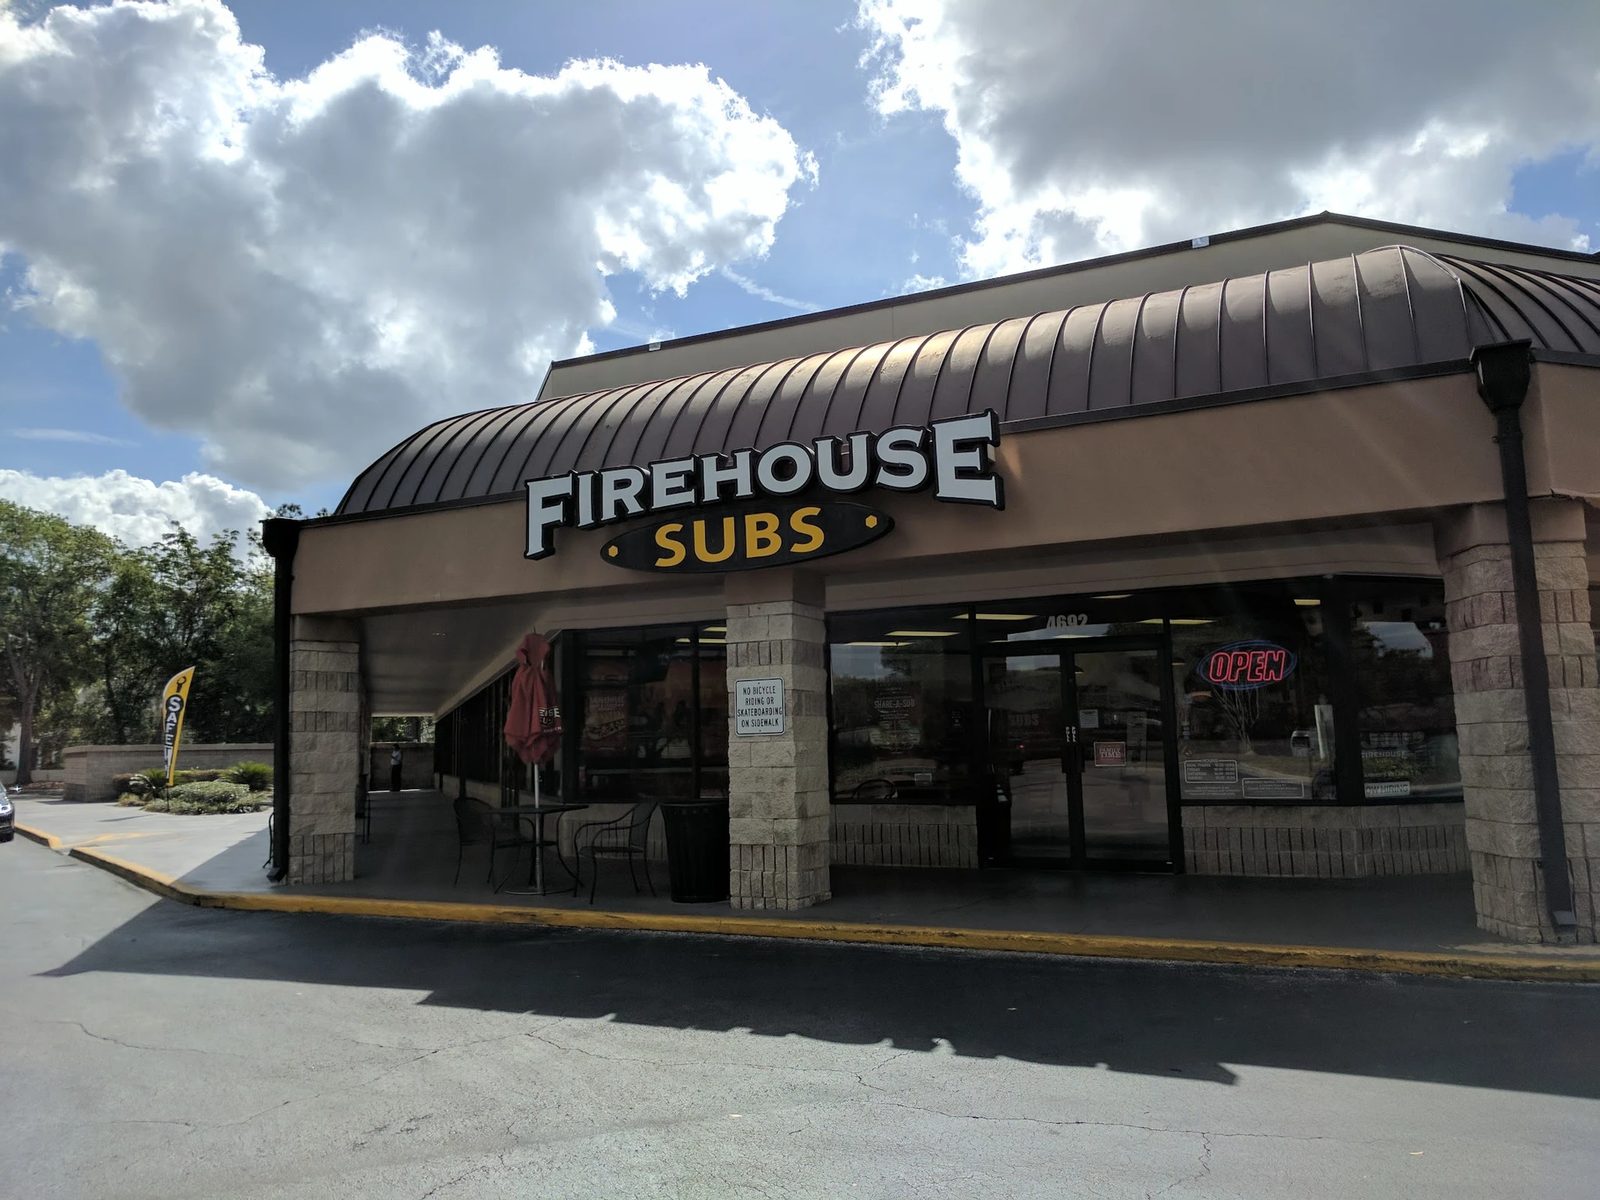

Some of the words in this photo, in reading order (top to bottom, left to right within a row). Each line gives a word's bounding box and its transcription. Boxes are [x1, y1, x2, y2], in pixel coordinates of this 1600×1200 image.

[525, 409, 1002, 559] FIREHOUSE
[654, 506, 826, 568] SUBS
[1208, 648, 1286, 683] OPEN
[742, 687, 751, 696] NO
[753, 685, 776, 695] BICYCLE
[745, 697, 765, 706] RIDING
[766, 696, 775, 705] OR
[737, 706, 784, 717] SKATEBOARDING
[741, 719, 750, 728] ON
[751, 718, 779, 727] SIDEWALK
